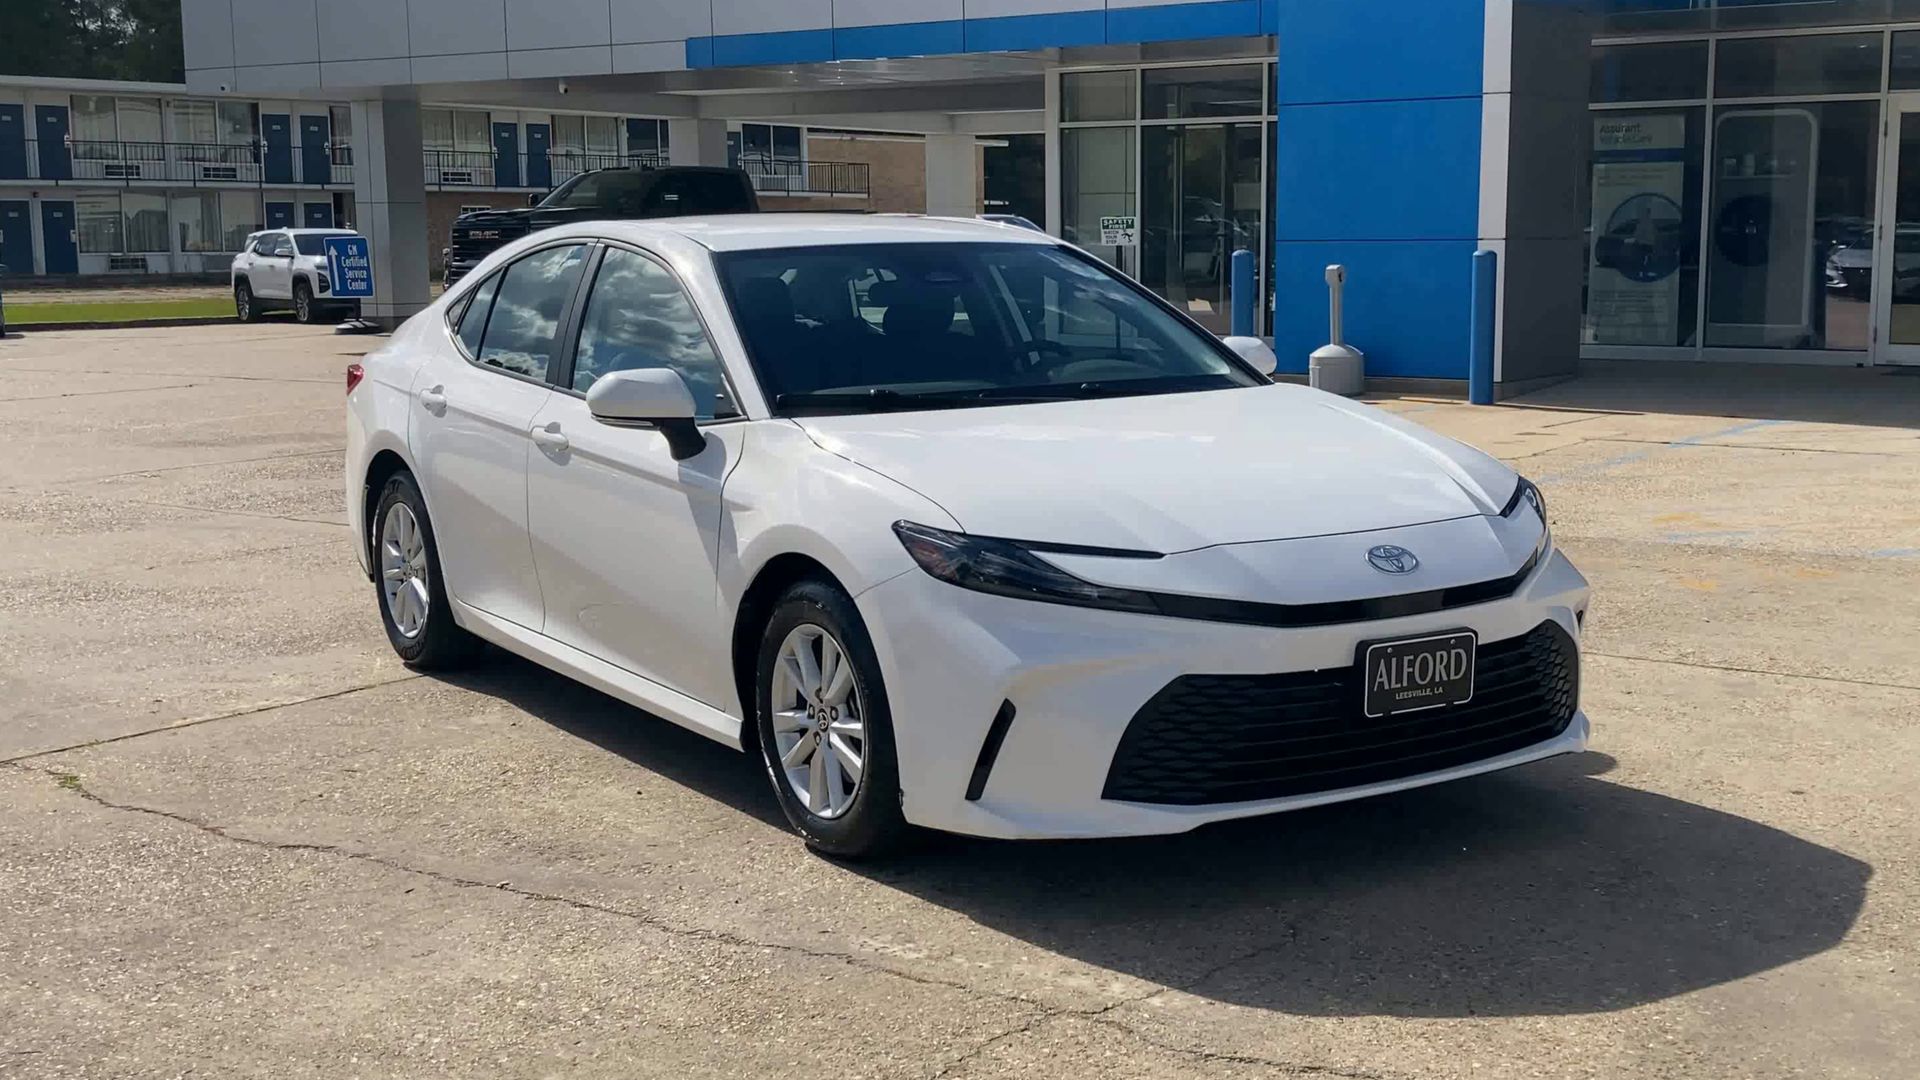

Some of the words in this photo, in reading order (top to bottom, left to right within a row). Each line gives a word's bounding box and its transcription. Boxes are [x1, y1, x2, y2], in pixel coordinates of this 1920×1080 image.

[1600, 122, 1641, 133] Assurant
[1103, 218, 1132, 226] SAFETY
[469, 230, 499, 239] GMC
[347, 244, 358, 255] GM
[341, 255, 368, 268] Certified
[344, 267, 367, 279] Service
[347, 279, 367, 291] Center
[1373, 648, 1467, 692] ALFORD
[1395, 687, 1433, 700] LEESVILLE,
[1434, 686, 1444, 695] LA
